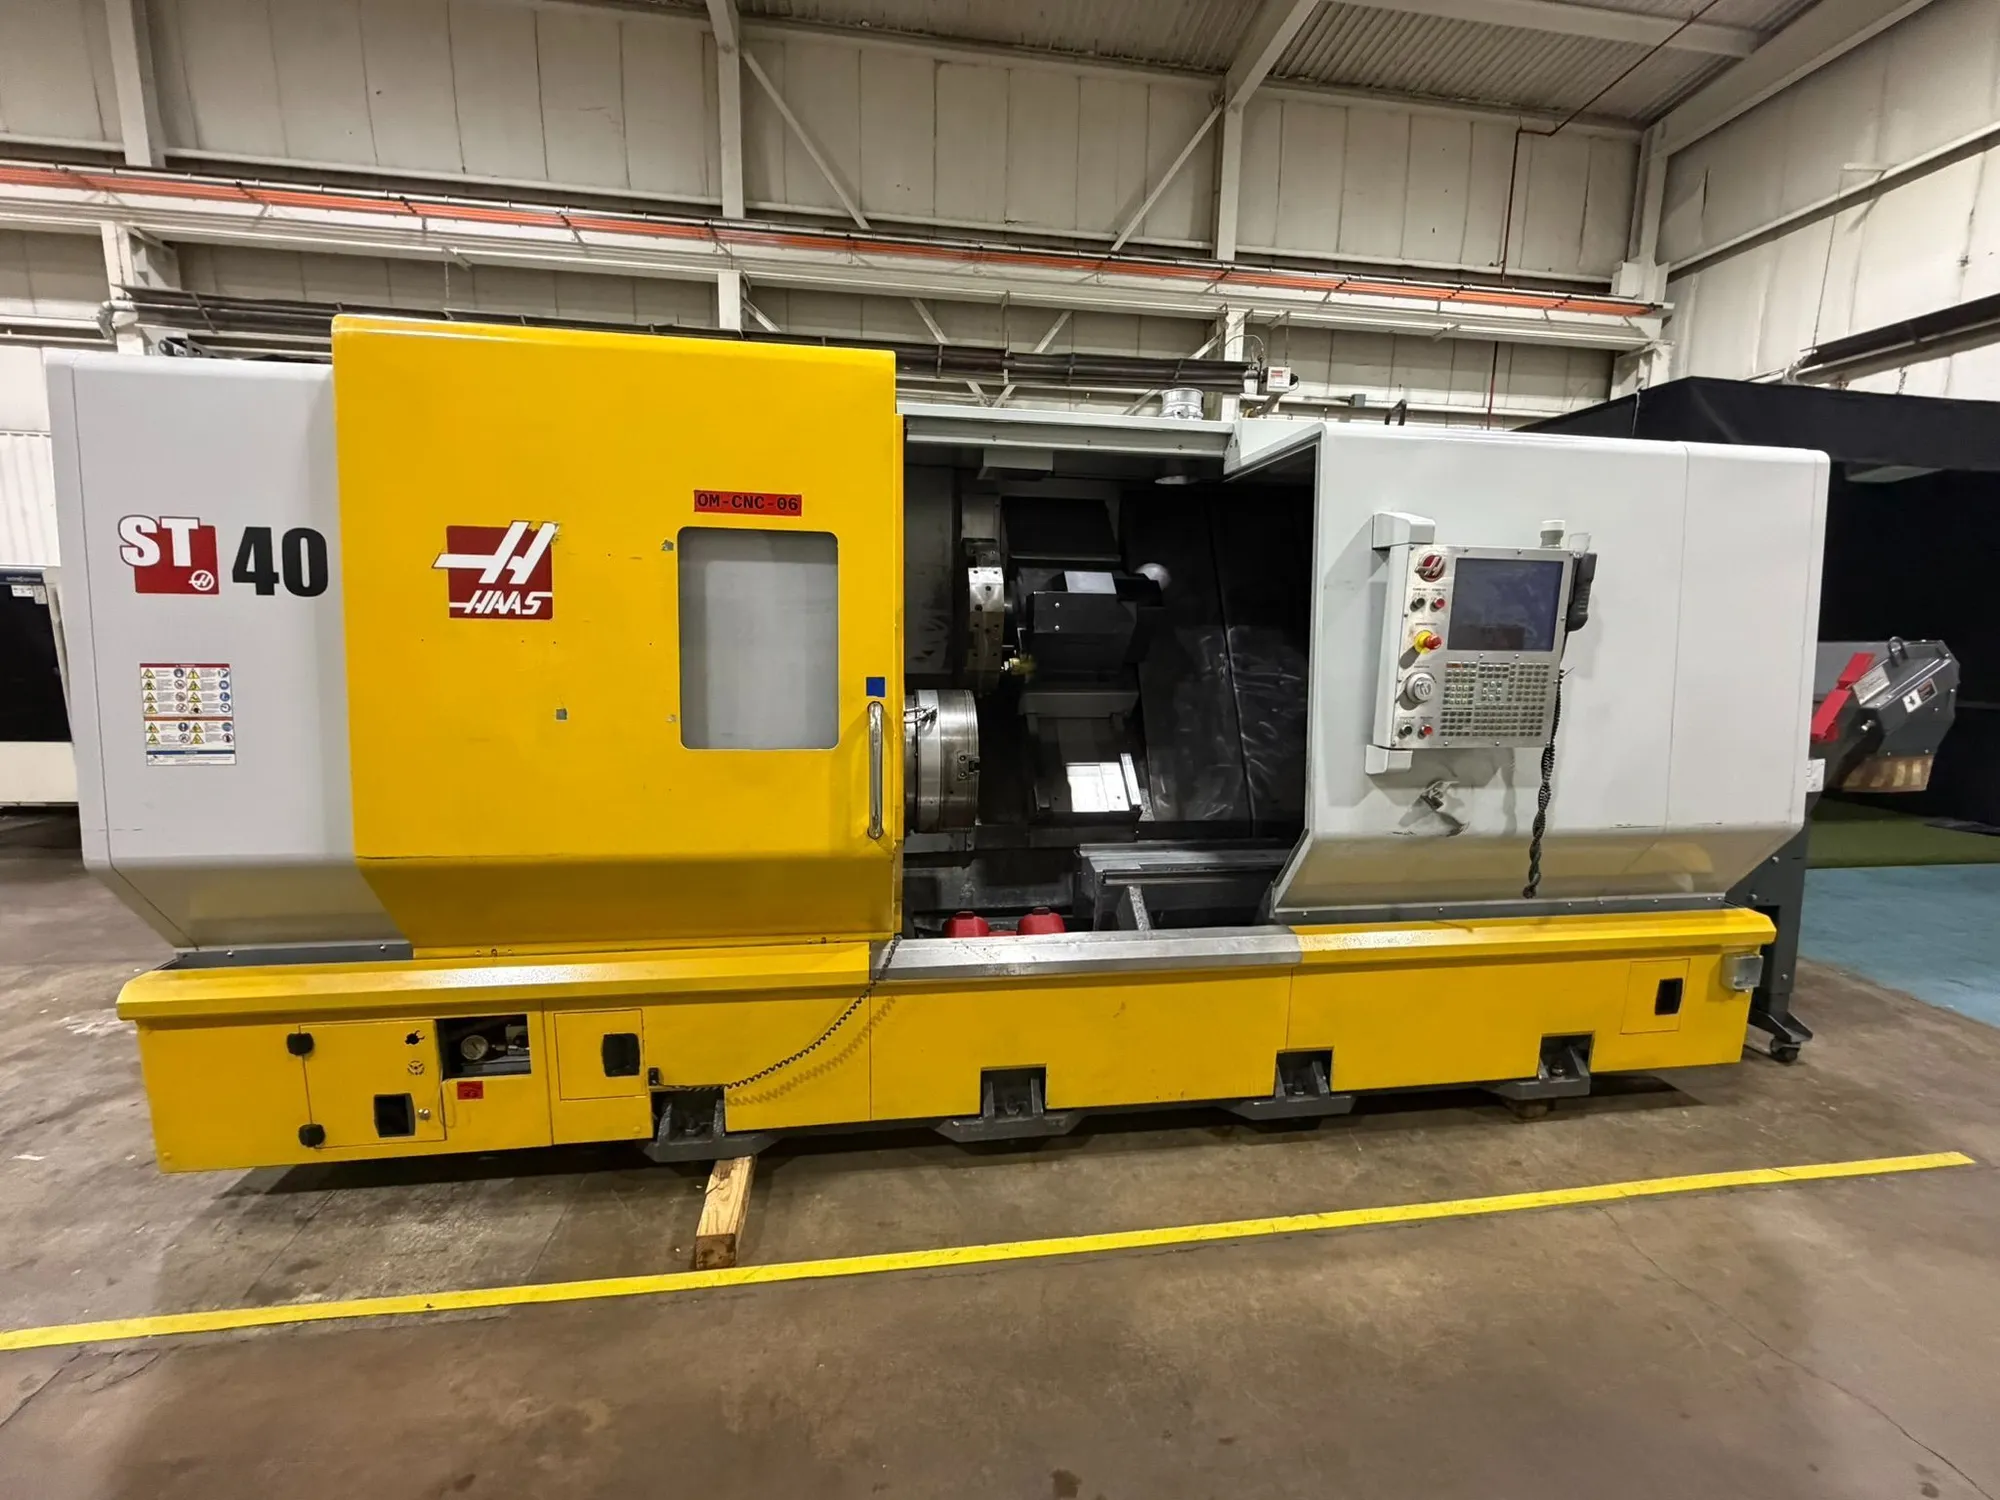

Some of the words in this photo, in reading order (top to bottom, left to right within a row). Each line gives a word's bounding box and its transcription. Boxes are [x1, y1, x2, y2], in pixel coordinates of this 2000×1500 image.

[697, 493, 798, 511] OM-CNC-06
[118, 515, 200, 567] ST
[232, 526, 329, 597] 40
[449, 590, 553, 615] HAAS
